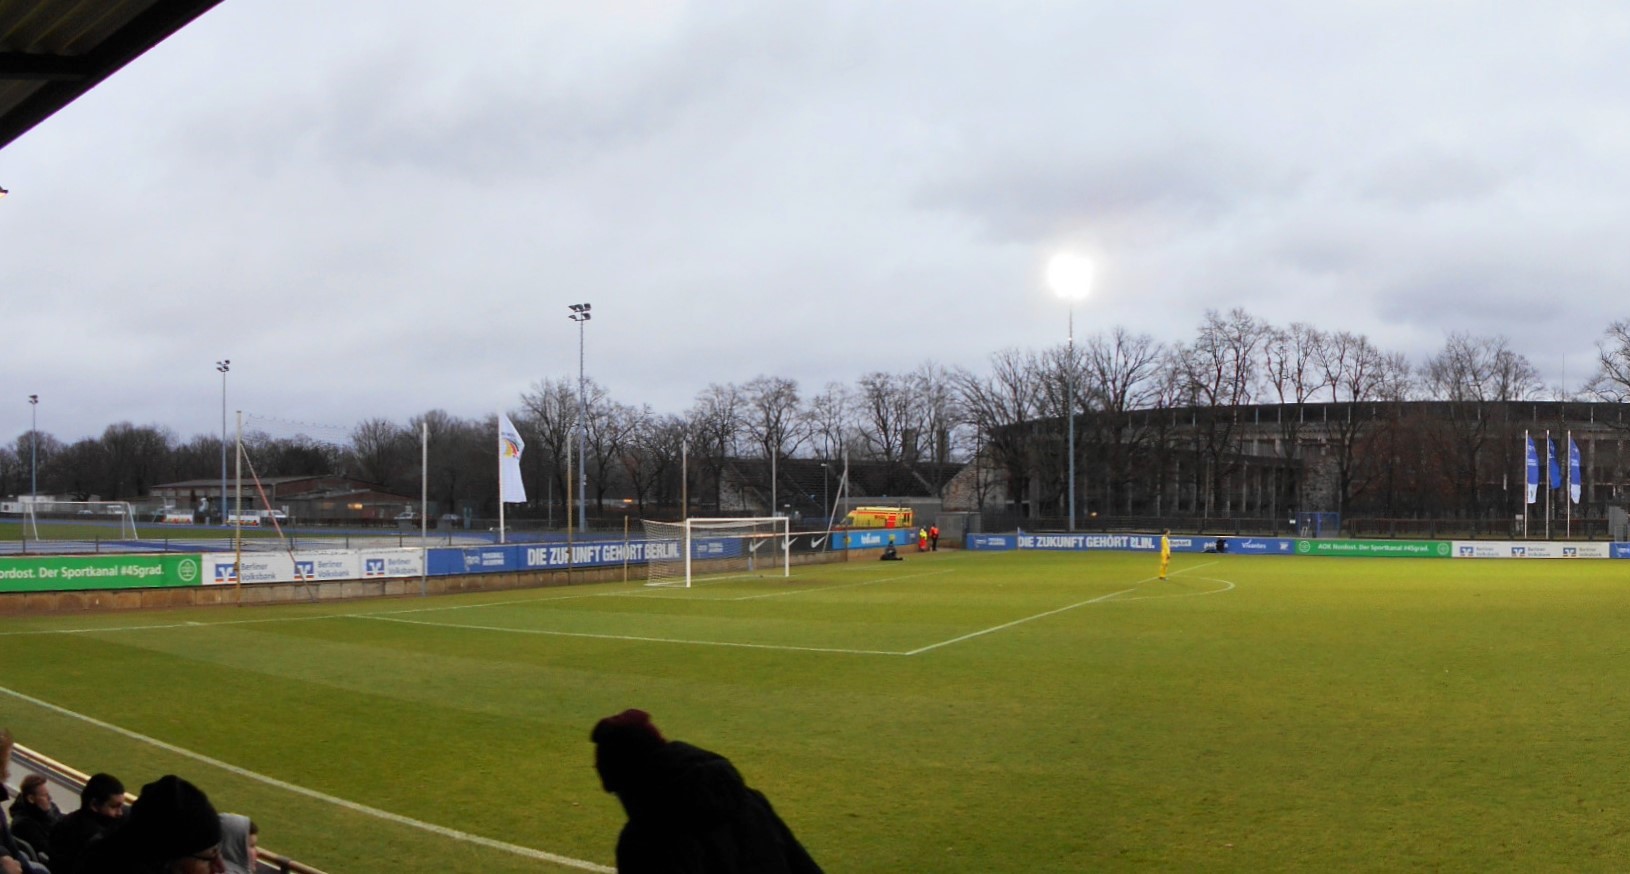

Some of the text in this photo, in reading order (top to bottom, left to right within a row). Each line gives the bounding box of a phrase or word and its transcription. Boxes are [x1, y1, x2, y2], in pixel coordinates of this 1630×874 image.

[1018, 536, 1034, 548] DIE
[1036, 536, 1084, 548] ZUKUNFT
[1086, 534, 1128, 548] GEHÖRT
[528, 547, 546, 566] DIE
[602, 542, 643, 562] GEHÖRT
[39, 567, 58, 578] Der
[61, 565, 118, 580] Sportkanal
[121, 564, 164, 578] #45grad.
